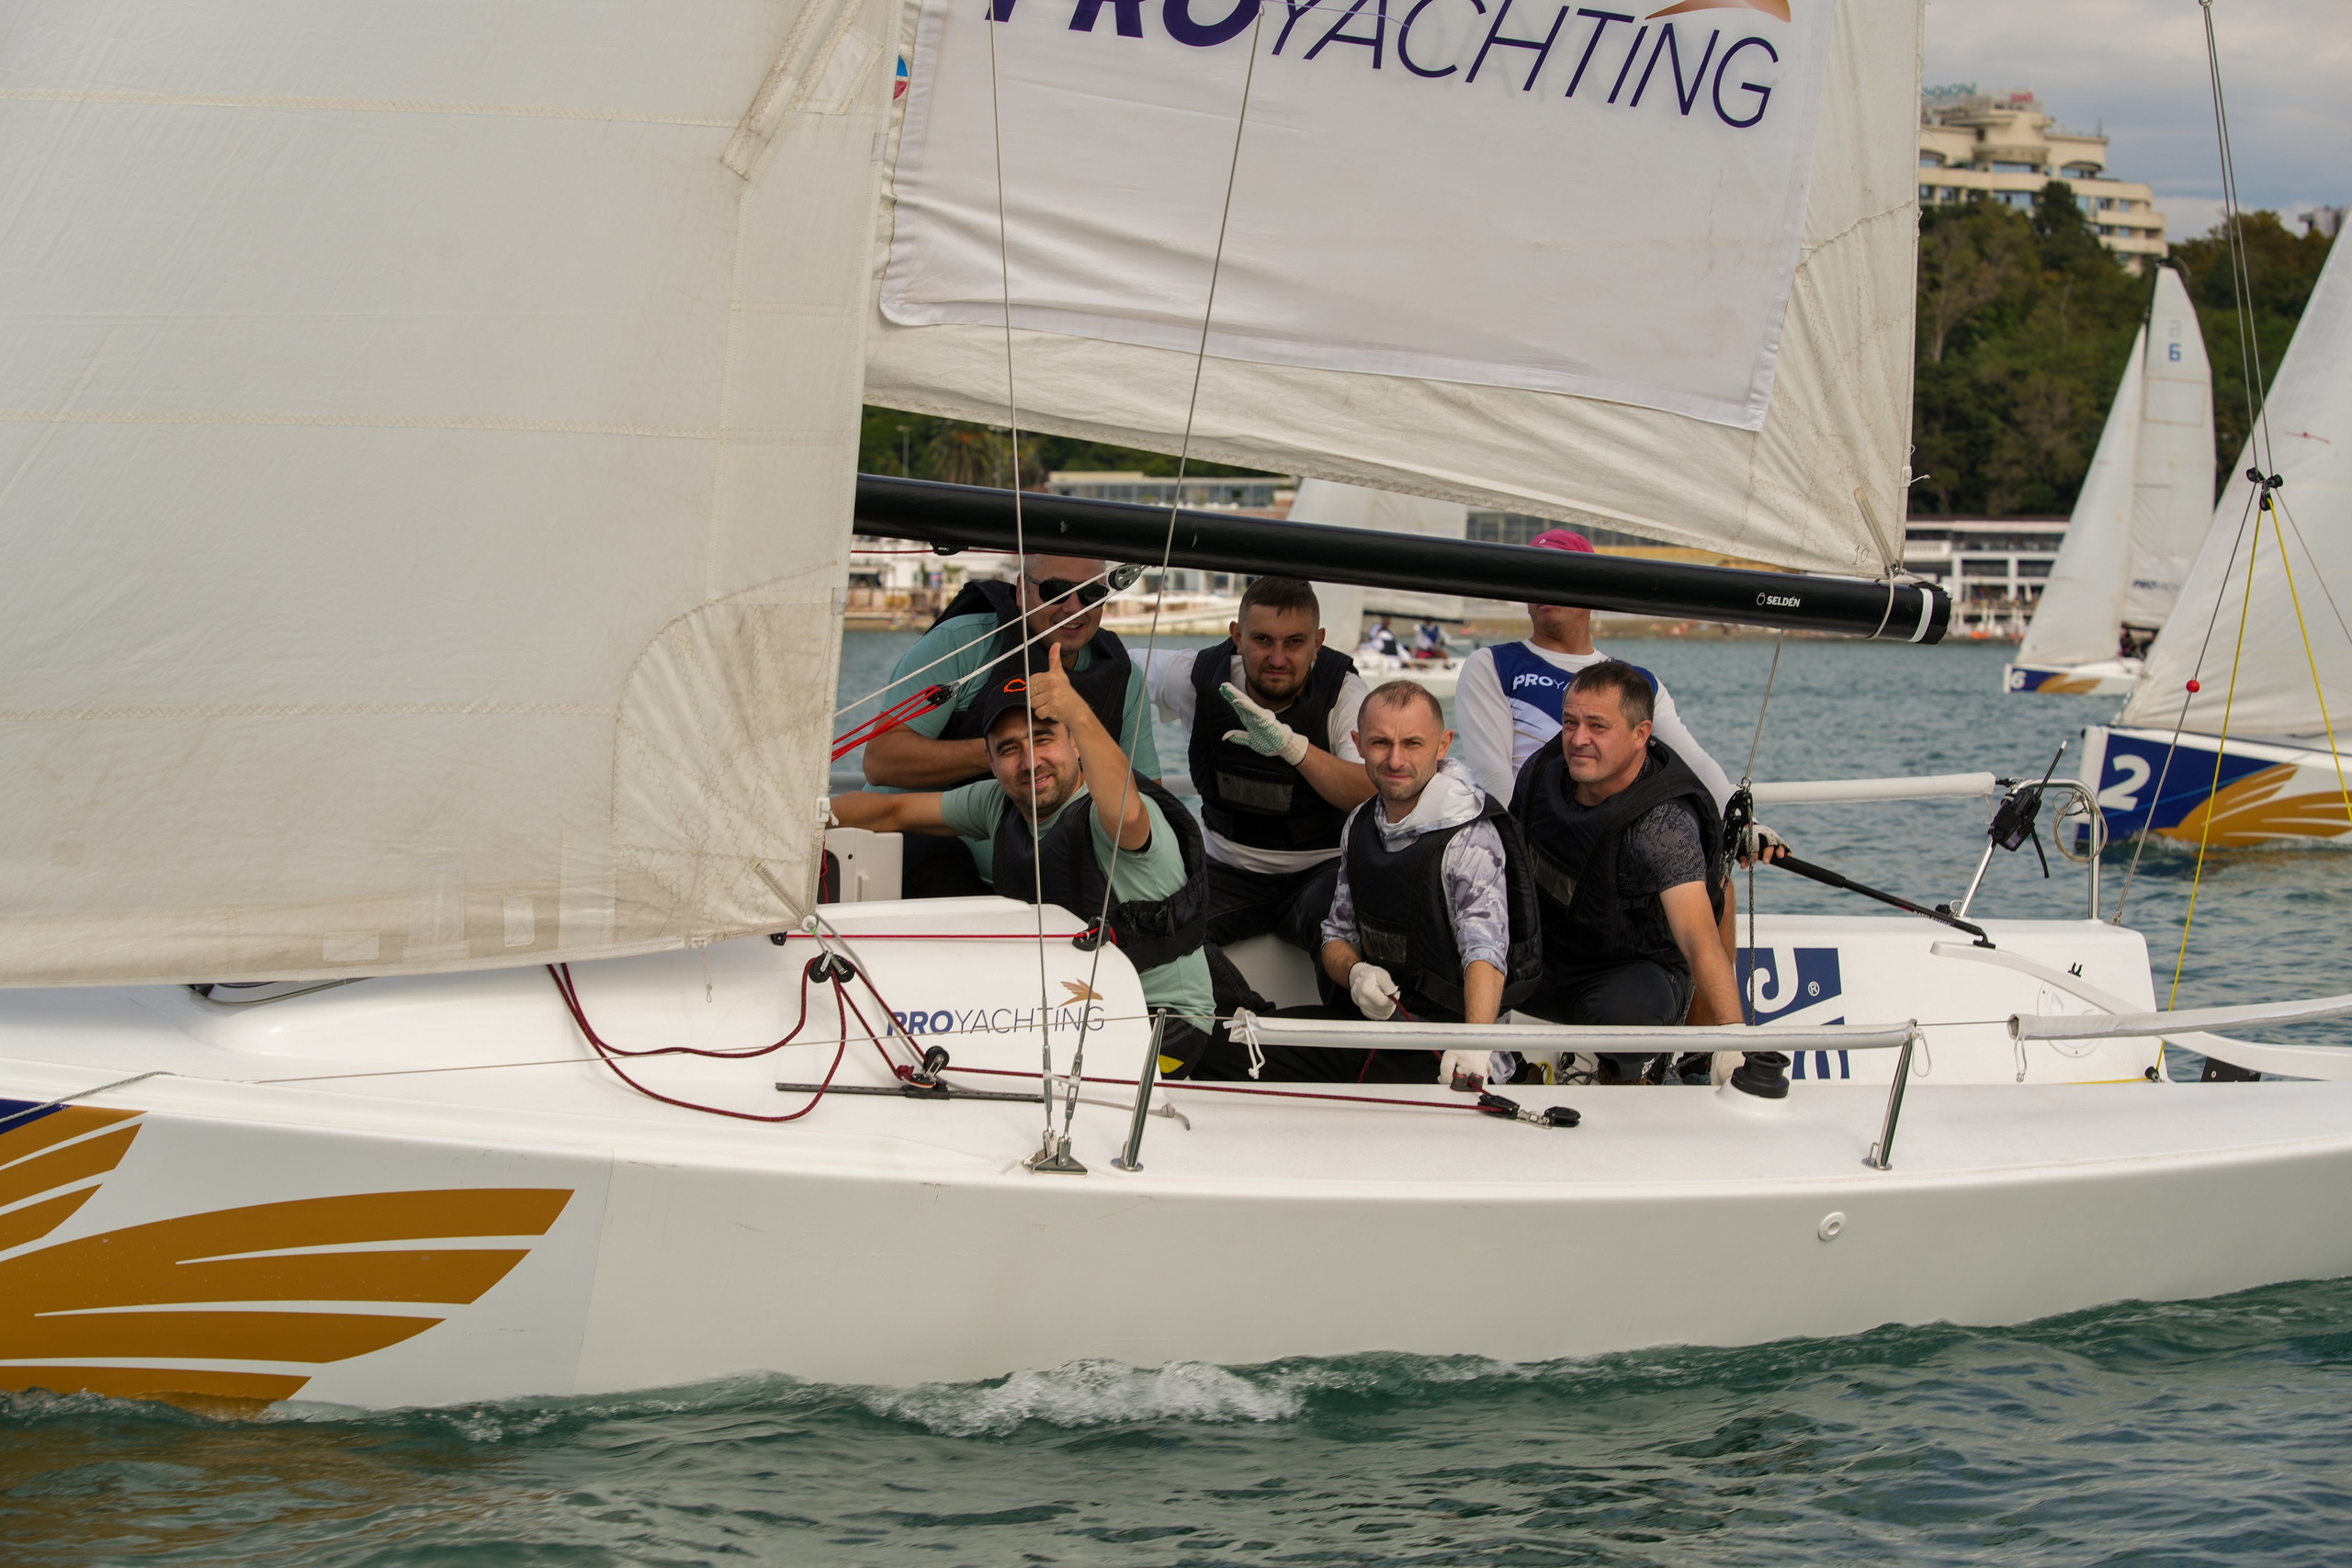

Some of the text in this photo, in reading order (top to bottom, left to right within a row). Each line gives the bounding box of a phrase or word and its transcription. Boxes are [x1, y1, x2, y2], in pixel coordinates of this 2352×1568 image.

[2168, 343, 2182, 362] 6
[1766, 595, 1801, 607] SELDÉN
[2011, 671, 2027, 689] 6
[2098, 754, 2151, 811] 2
